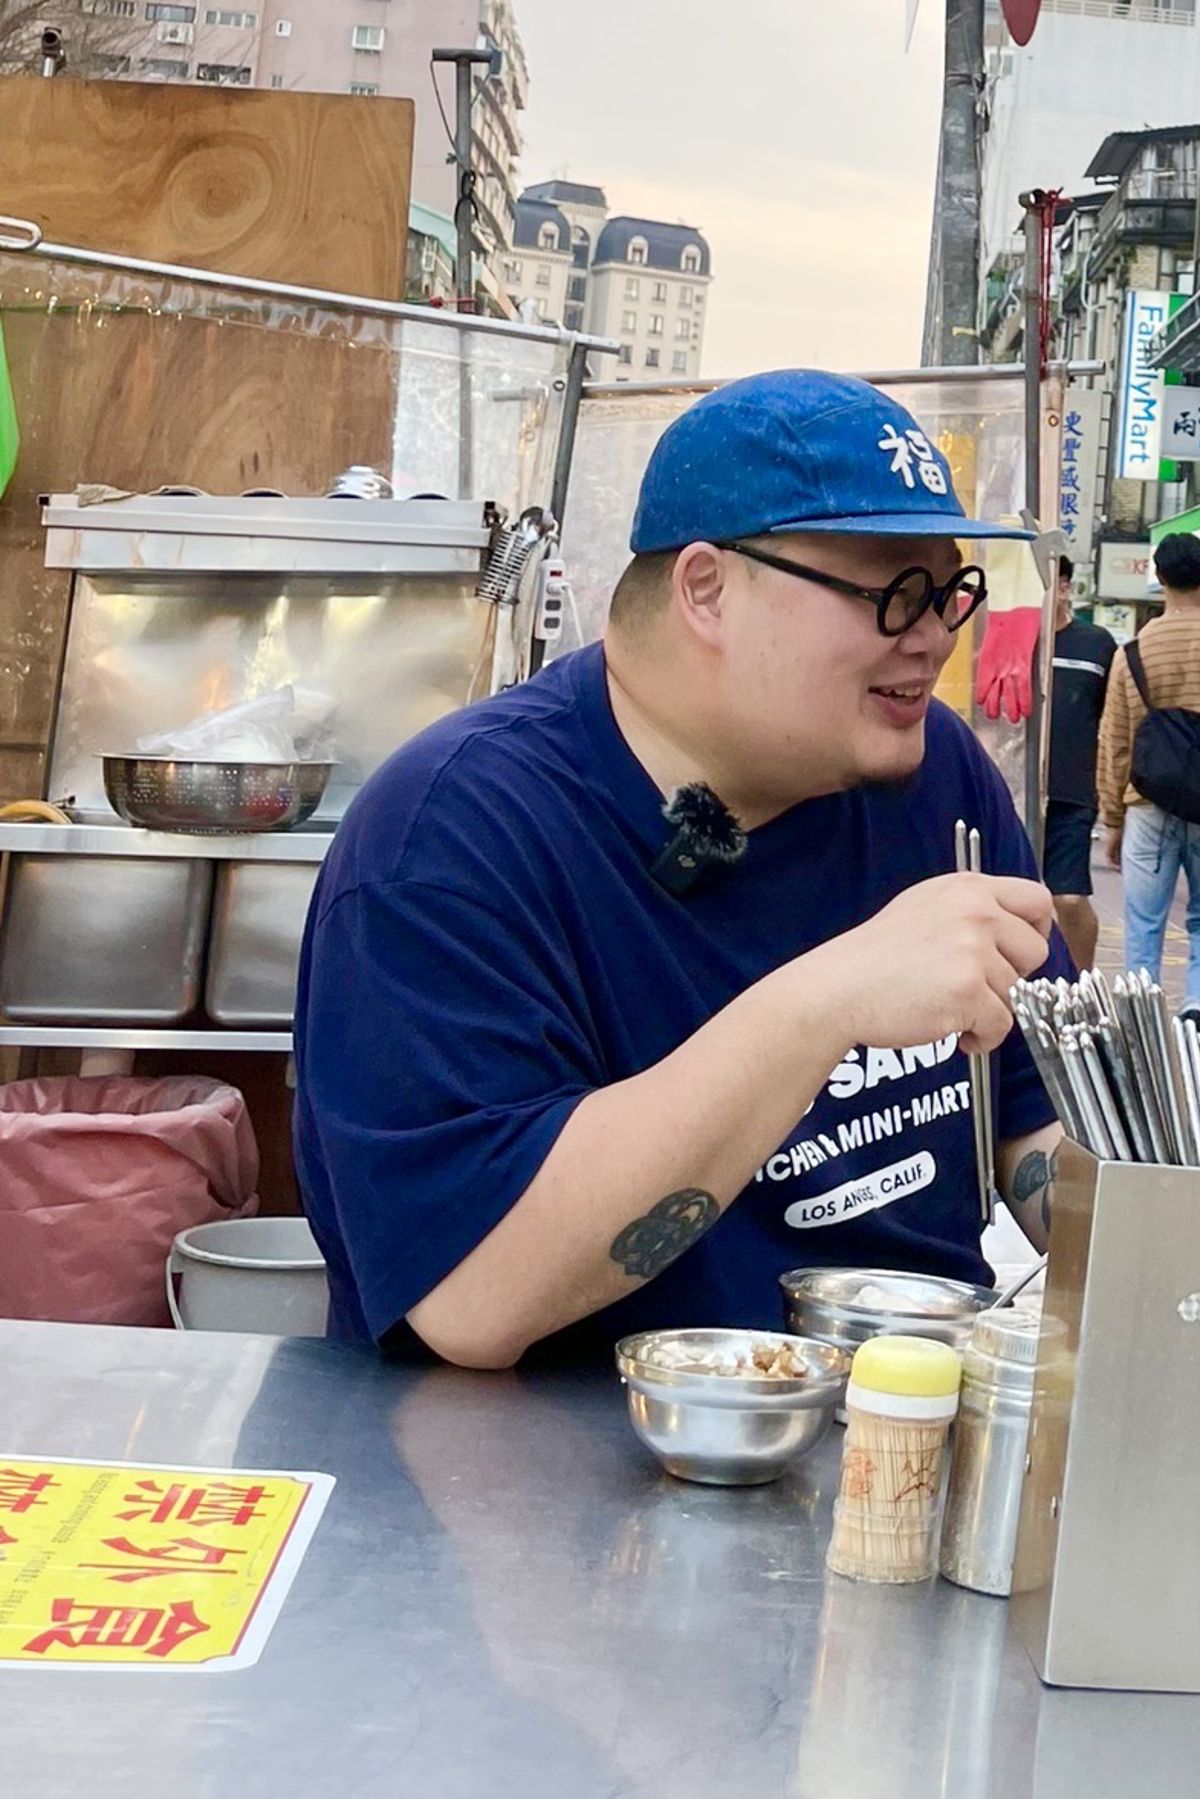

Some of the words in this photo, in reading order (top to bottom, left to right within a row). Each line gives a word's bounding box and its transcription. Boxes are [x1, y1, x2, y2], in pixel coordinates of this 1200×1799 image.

[1129, 305, 1163, 463] FamilyMart
[878, 423, 948, 495] 福
[837, 1081, 971, 1153] MINI-MART
[801, 1200, 836, 1221] LOS
[22, 1480, 276, 1657] 禁外食
